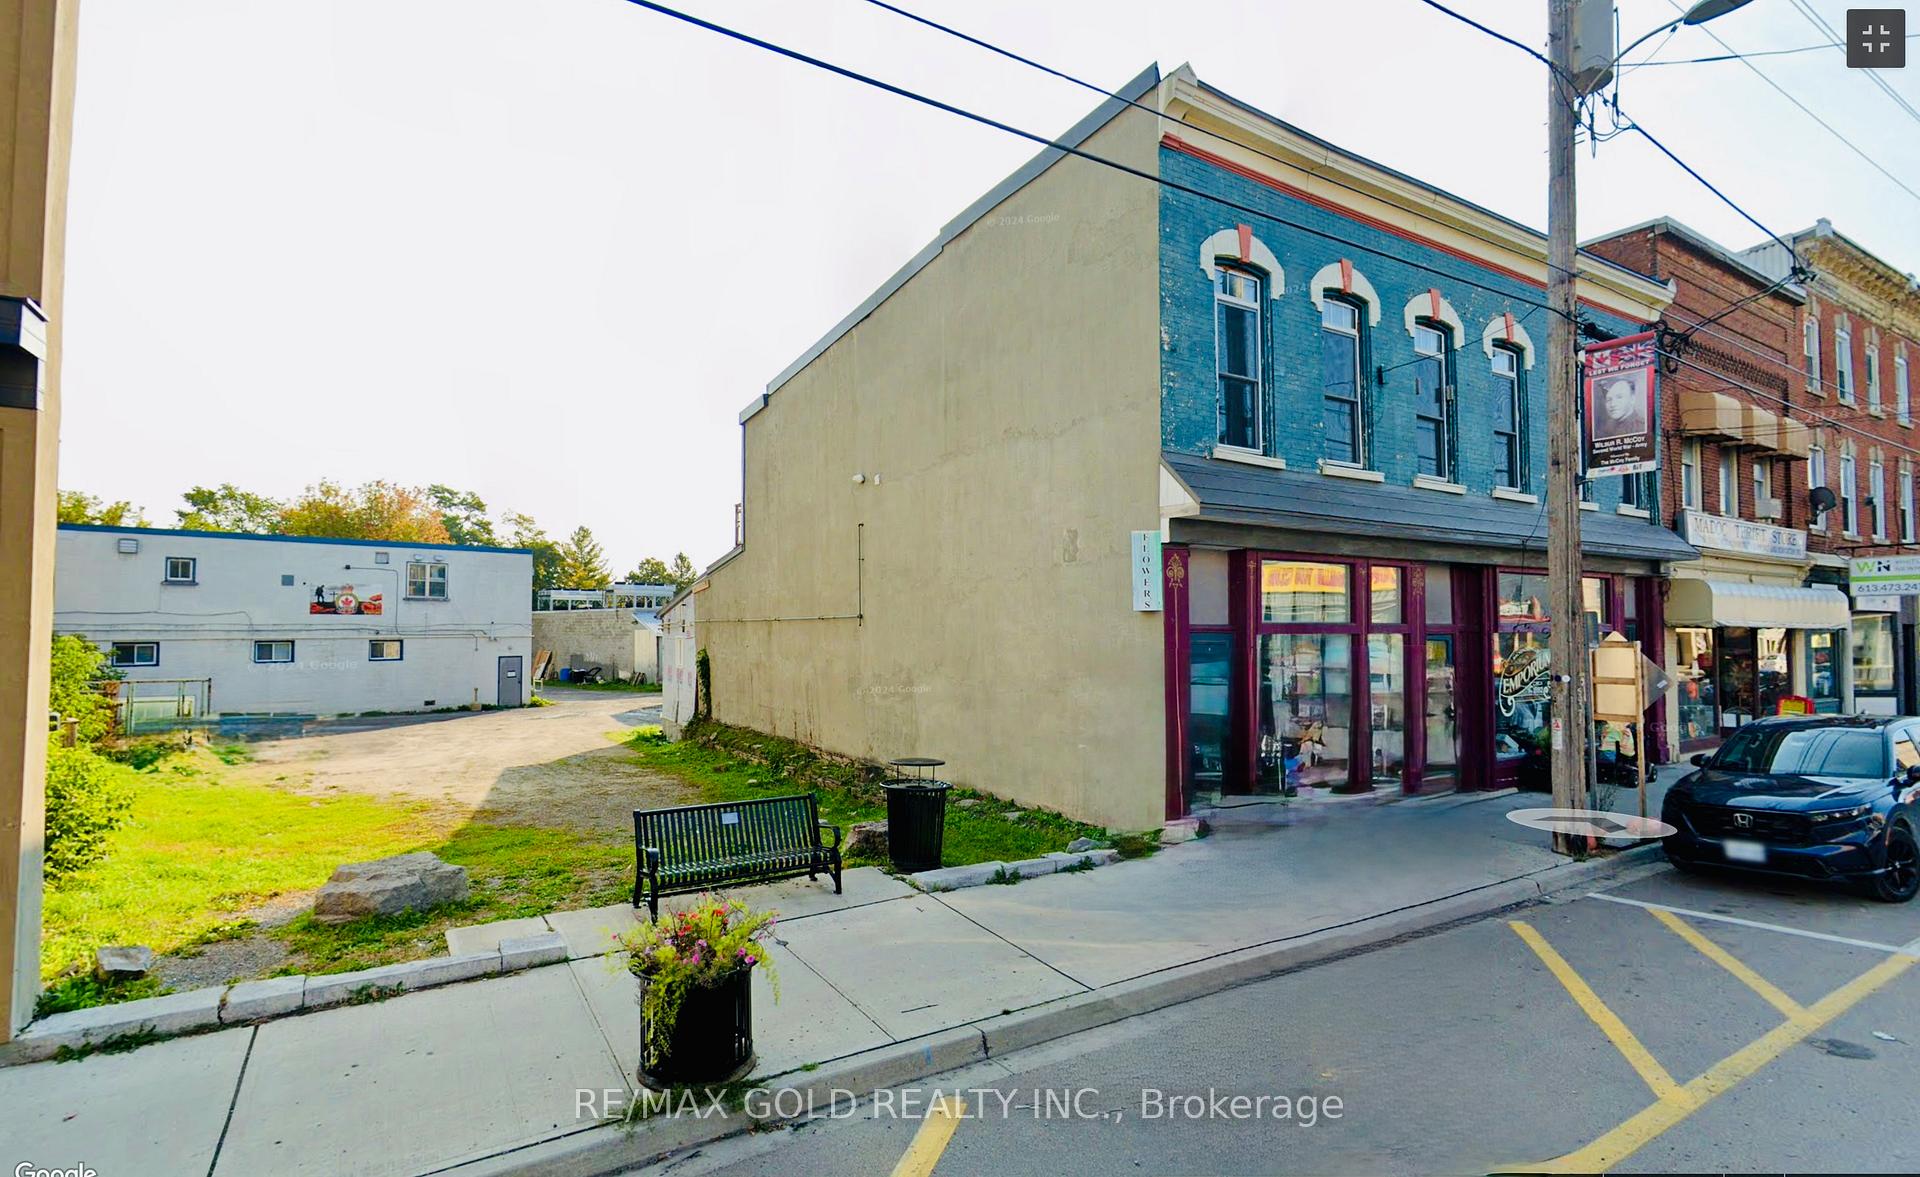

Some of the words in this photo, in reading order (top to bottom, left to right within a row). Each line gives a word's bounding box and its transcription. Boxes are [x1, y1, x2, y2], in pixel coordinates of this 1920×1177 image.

[1589, 368, 1606, 377] LEST
[1607, 365, 1619, 373] WE
[1620, 359, 1650, 371] FORGET
[1735, 524, 1767, 542] THRIFT
[1771, 528, 1798, 546] STORE
[1141, 533, 1151, 608] FLOWERS
[1857, 583, 1920, 592] 613.473.24
